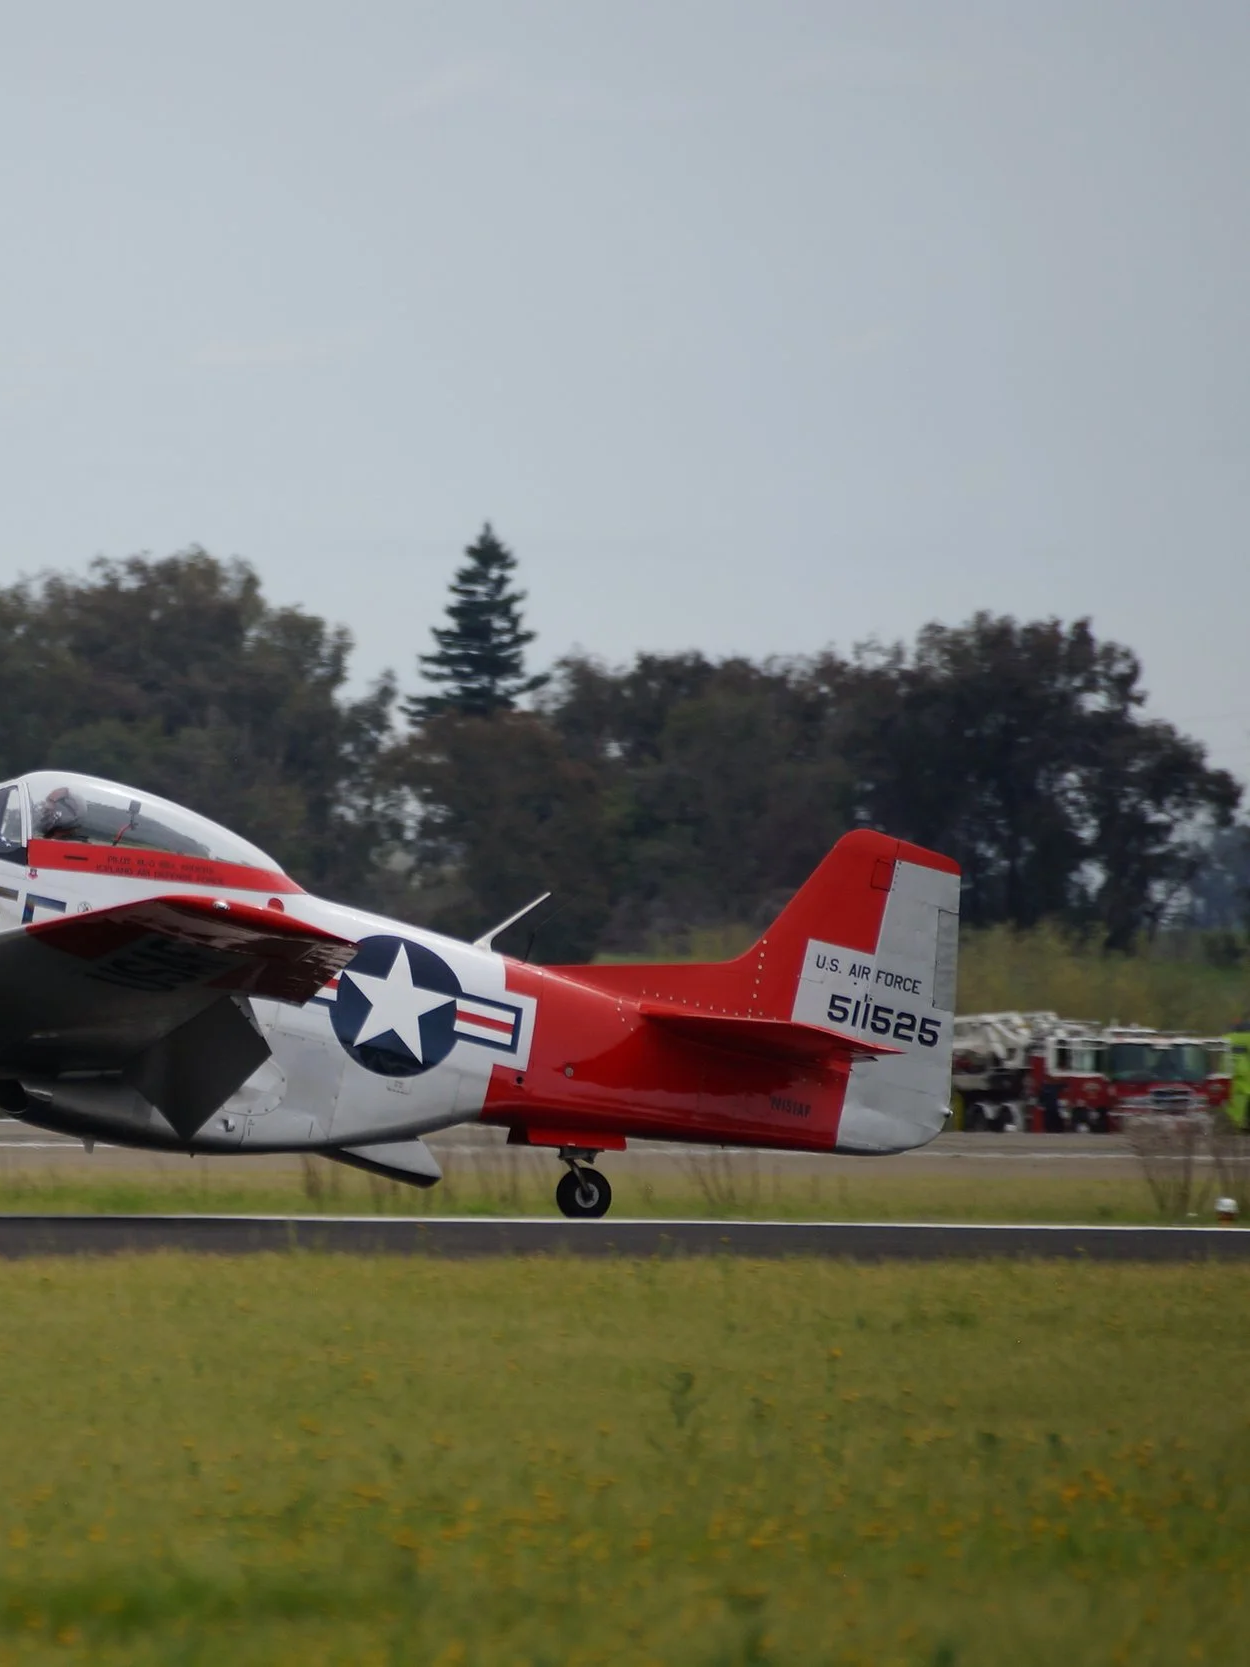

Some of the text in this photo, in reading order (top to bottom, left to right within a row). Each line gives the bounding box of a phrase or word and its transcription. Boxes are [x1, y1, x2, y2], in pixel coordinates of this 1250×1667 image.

[816, 955, 922, 995] U.S. AIR FORCE
[827, 993, 942, 1048] 511525
